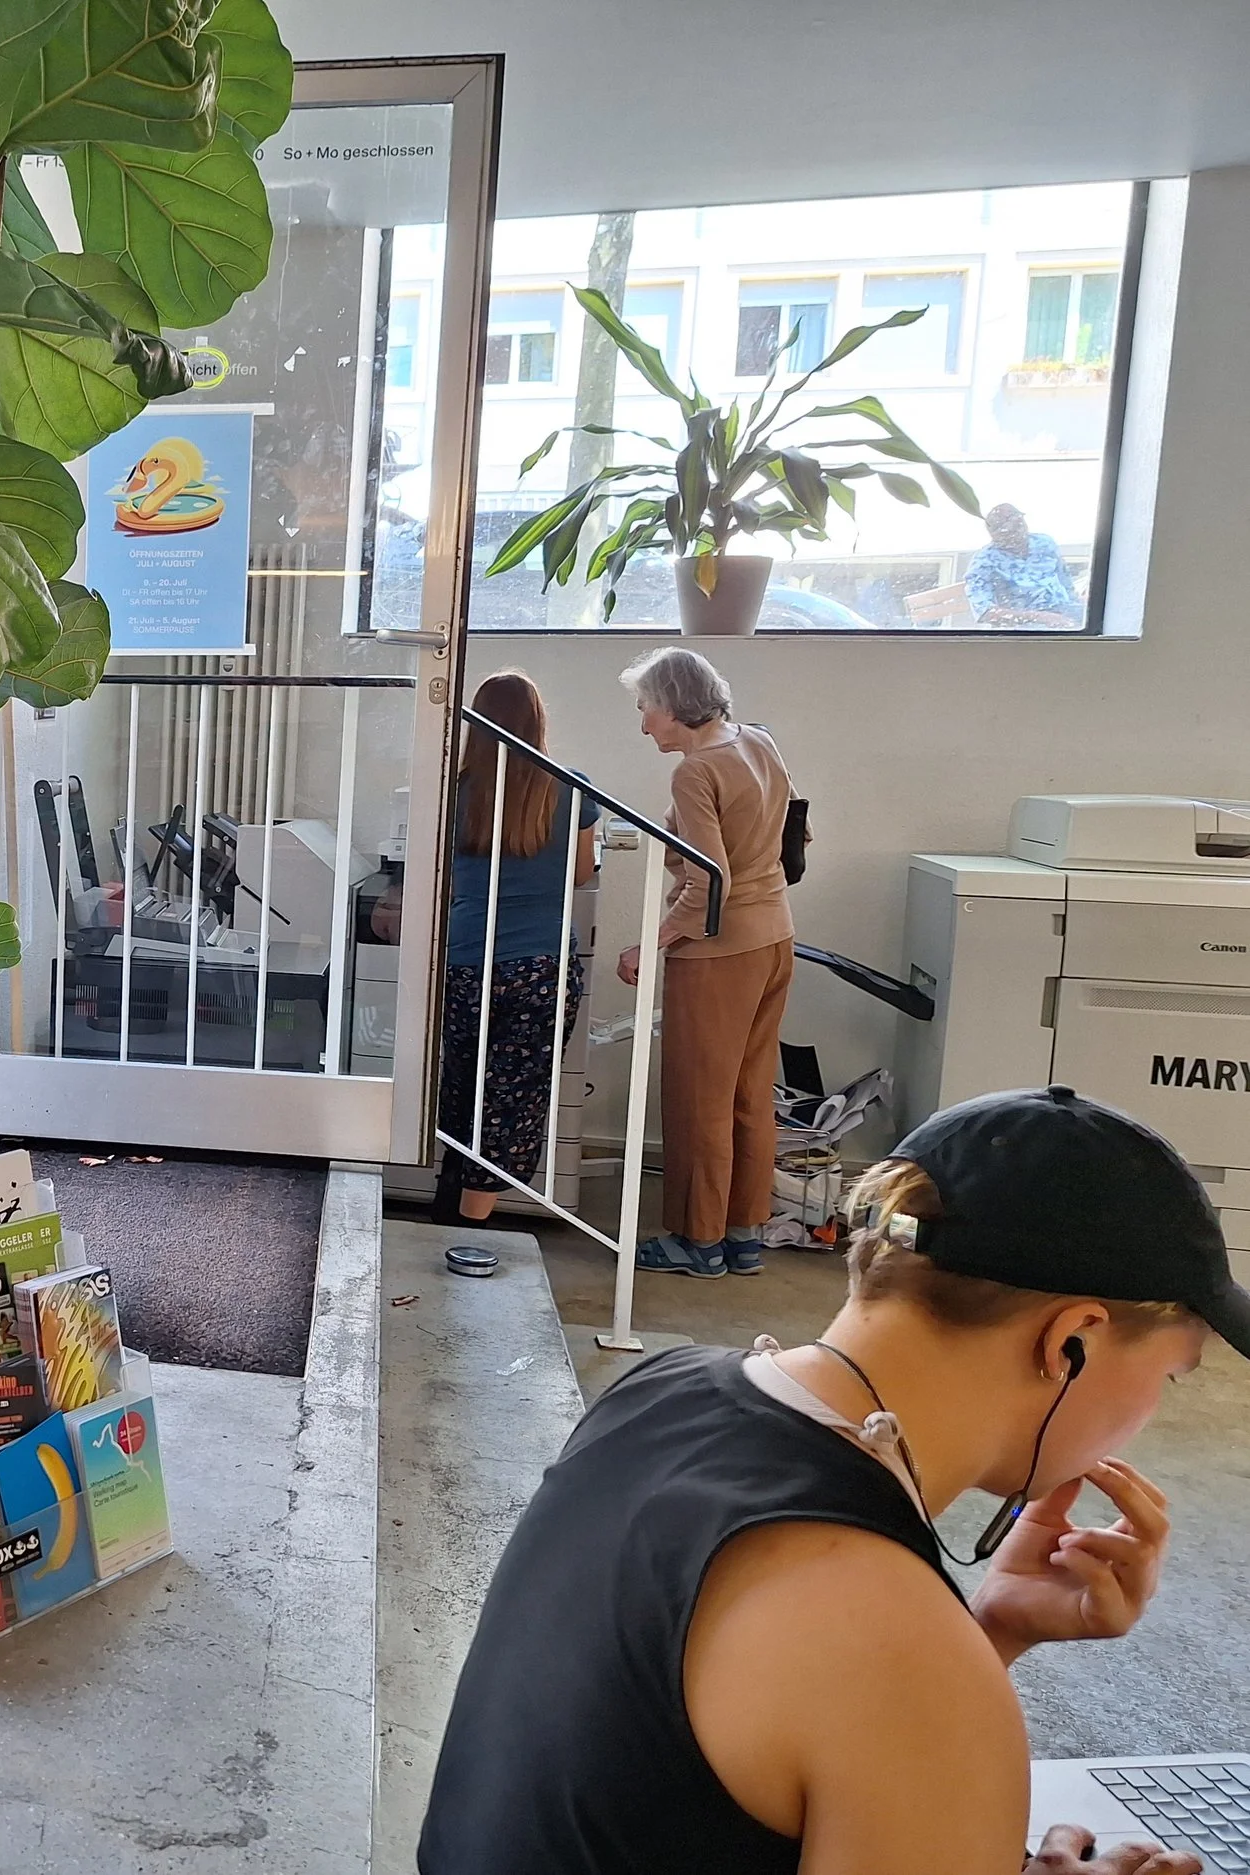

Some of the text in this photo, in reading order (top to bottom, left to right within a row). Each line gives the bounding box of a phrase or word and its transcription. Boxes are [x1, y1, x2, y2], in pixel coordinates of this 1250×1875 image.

[284, 148, 302, 161] So
[316, 147, 339, 160] Mo
[342, 144, 434, 163] geschlossen
[36, 156, 49, 168] Fr
[171, 616, 200, 625] August
[1200, 942, 1247, 954] Canon
